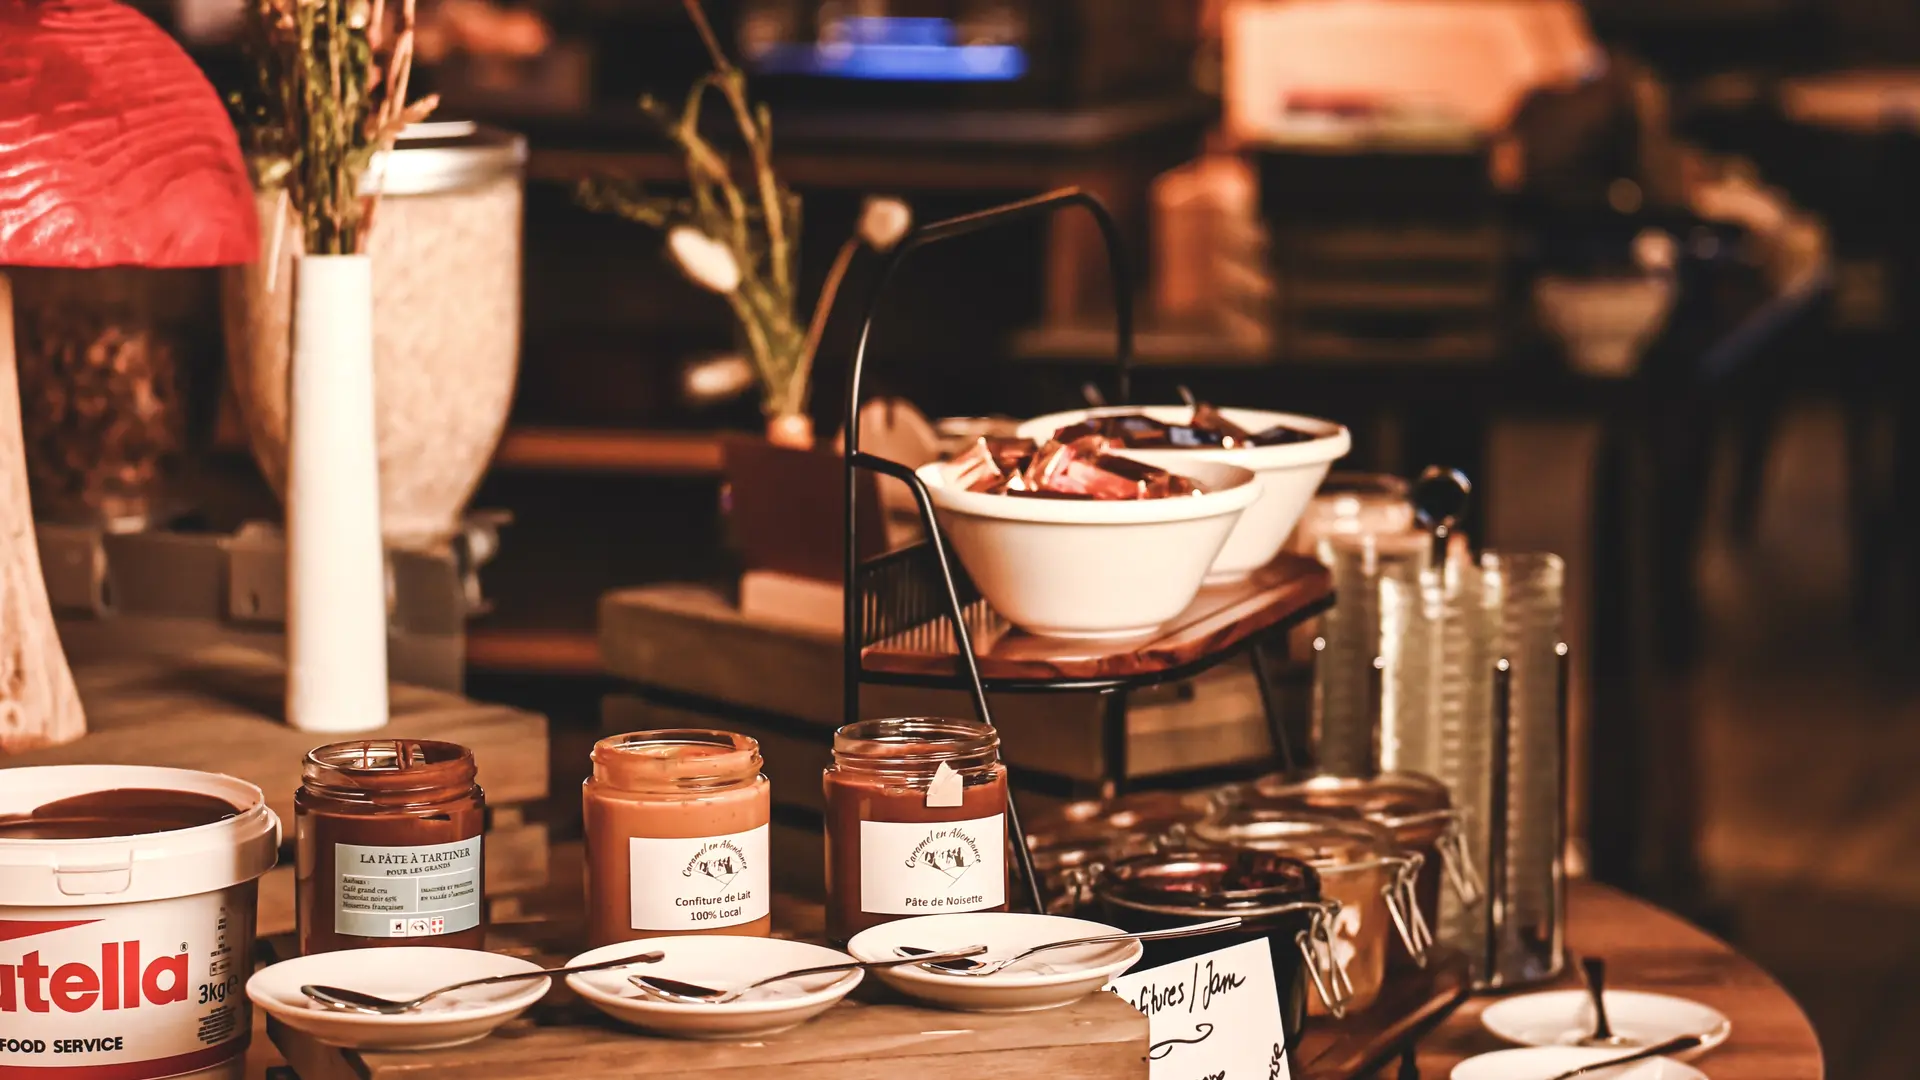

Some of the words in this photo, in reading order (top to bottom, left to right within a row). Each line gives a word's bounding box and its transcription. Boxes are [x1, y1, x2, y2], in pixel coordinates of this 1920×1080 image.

[360, 853, 376, 864] LA
[378, 852, 408, 864] PÂTE
[410, 852, 419, 864] À
[420, 847, 471, 863] TARTINER
[904, 830, 934, 869] Caramel
[936, 831, 947, 839] en
[949, 827, 982, 864] Abondance
[682, 843, 708, 877] Caramel
[720, 839, 748, 870] Abondance
[386, 868, 408, 876] POUR
[410, 866, 423, 874] LES
[424, 862, 451, 873] GRANDS
[342, 884, 356, 893] Café
[357, 886, 376, 894] grand
[342, 893, 369, 901] Chocolat
[371, 902, 404, 911] françaises
[675, 896, 722, 907] Confiture
[724, 893, 736, 903] de
[737, 890, 751, 901] Lait
[905, 897, 928, 907] Pâte
[930, 897, 943, 906] de
[946, 895, 983, 906] Noisette
[690, 910, 717, 921] 100%
[719, 906, 742, 919] Local
[1202, 959, 1247, 1011] Jam
[53, 1036, 123, 1054] SERVICE
